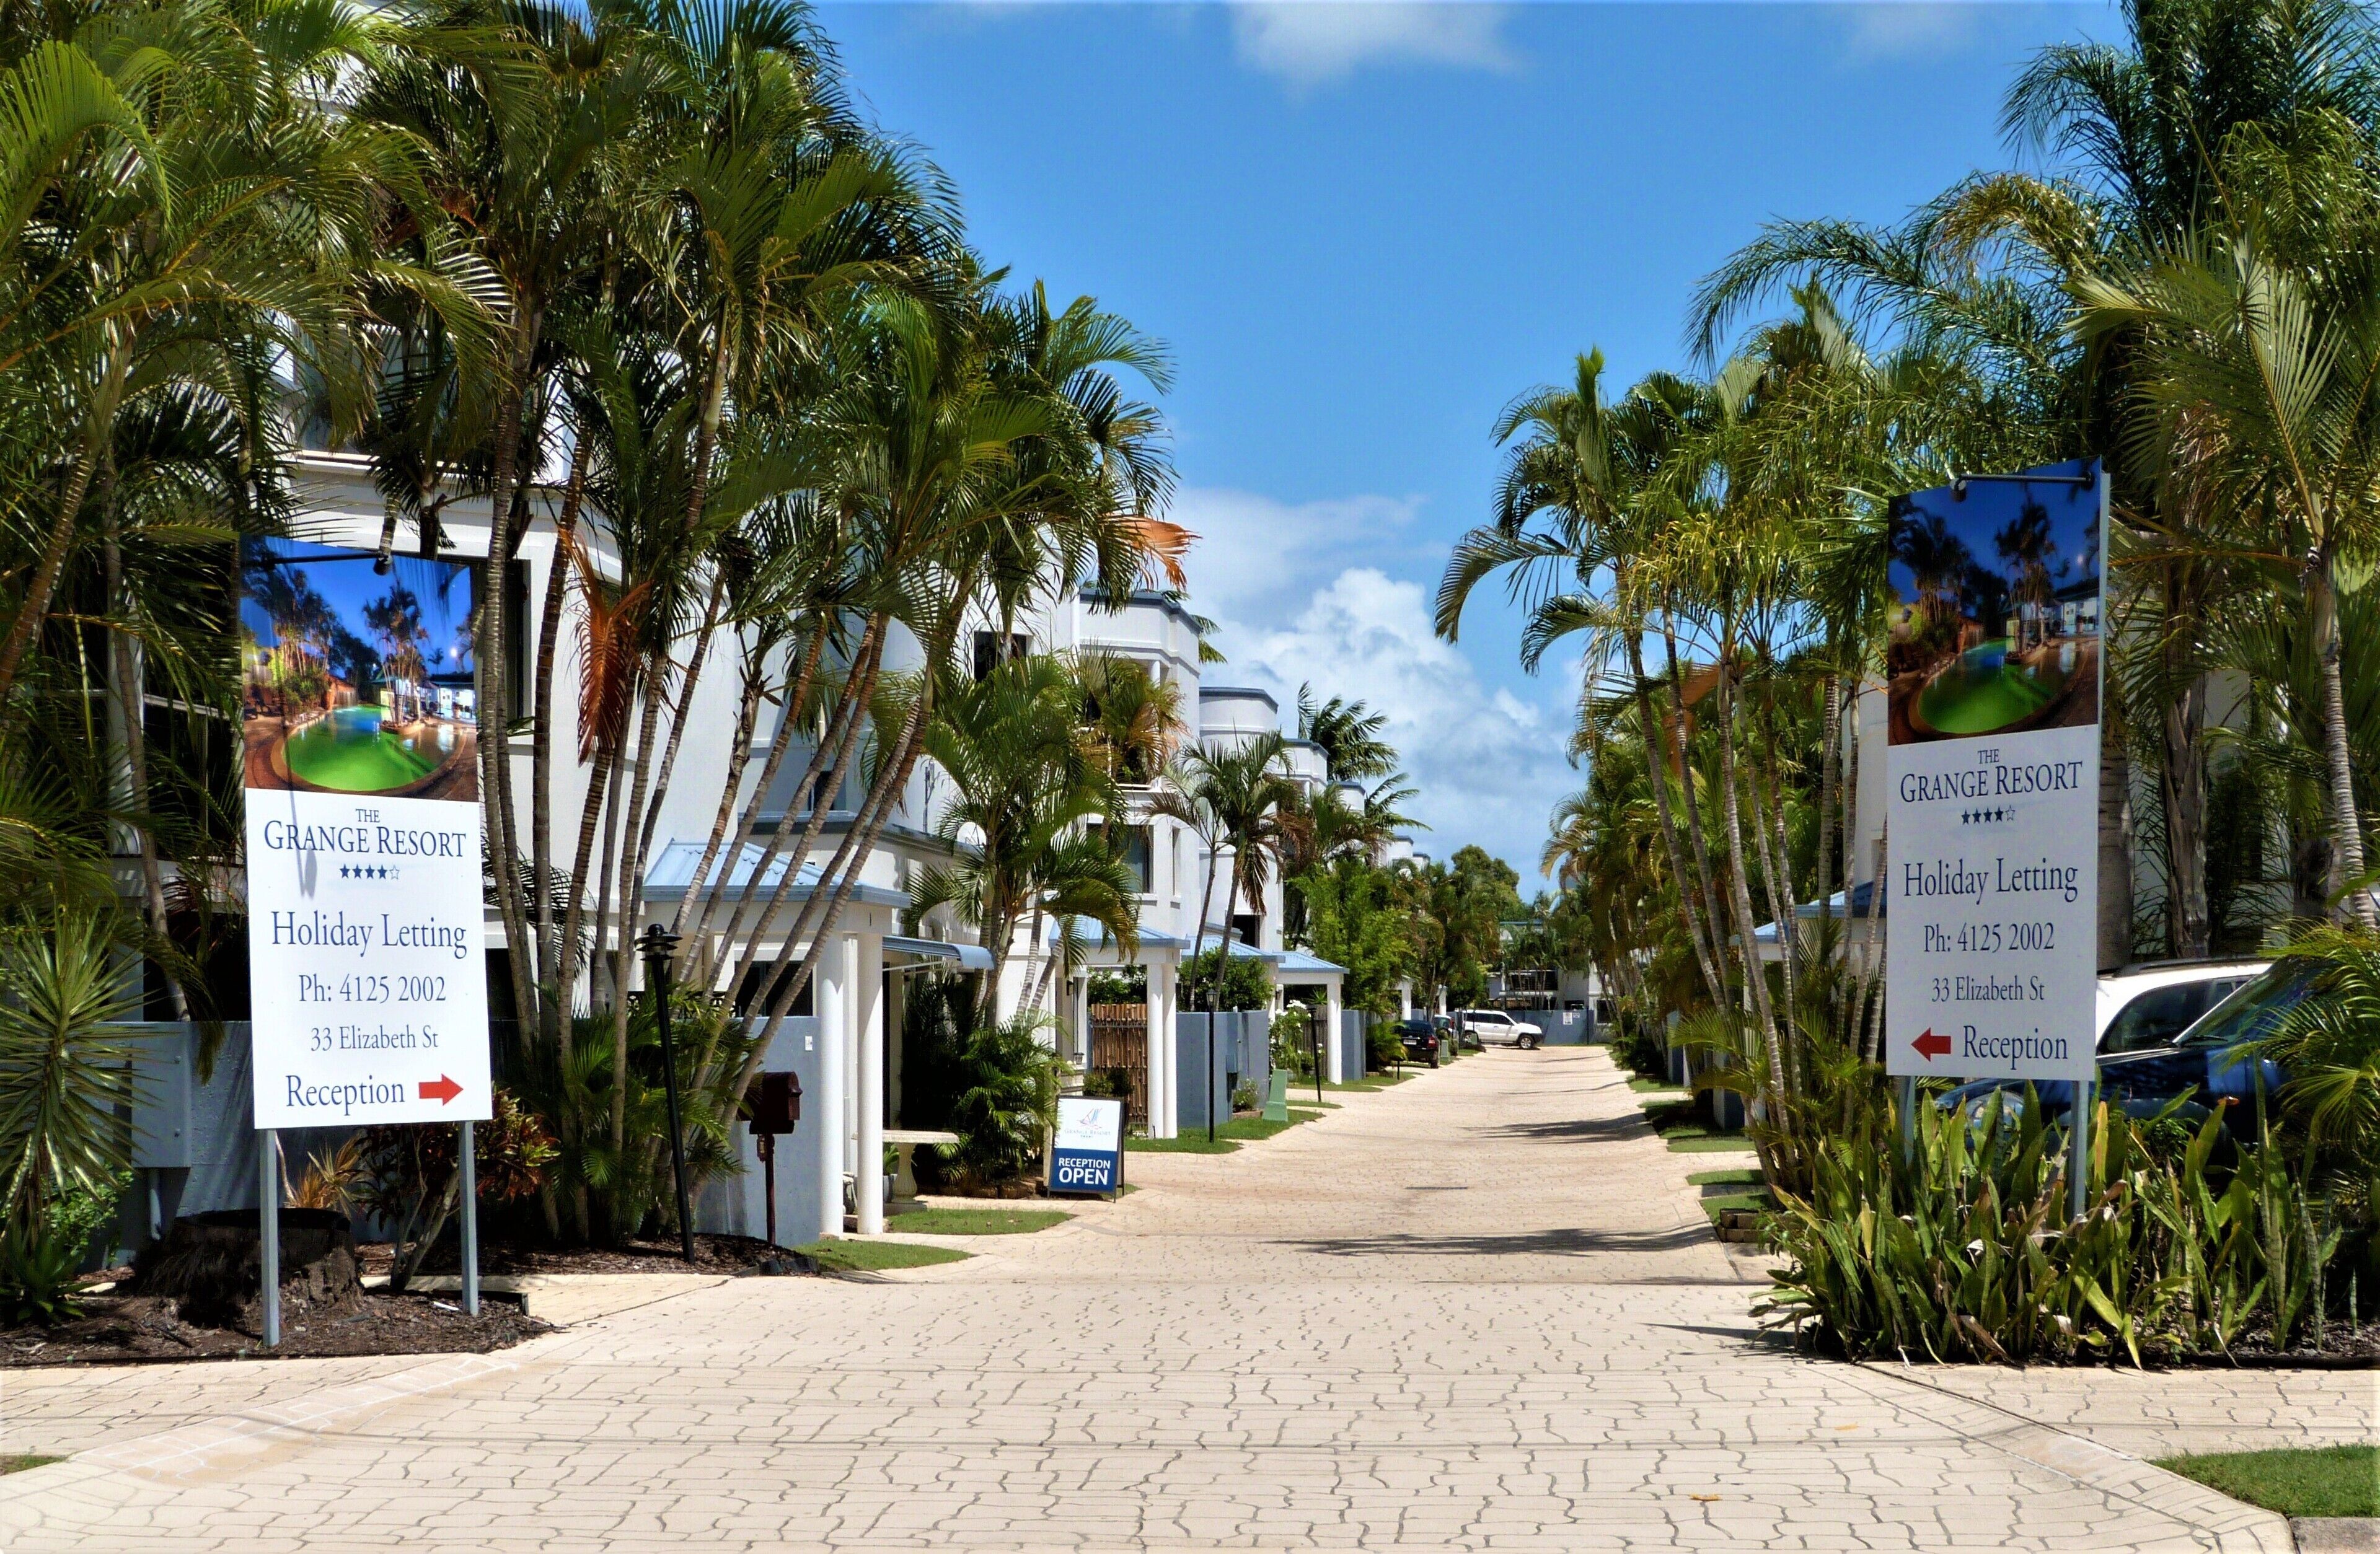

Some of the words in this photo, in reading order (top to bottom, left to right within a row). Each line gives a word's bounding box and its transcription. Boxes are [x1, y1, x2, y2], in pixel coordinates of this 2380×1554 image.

[1977, 748, 1999, 765] THE
[1900, 770, 1989, 803] GRANGE
[1994, 760, 2083, 796] RESORT
[355, 808, 381, 823] THE
[264, 820, 370, 854] GRANGE
[376, 826, 467, 858] RESORT
[1903, 858, 1990, 906] Holiday
[1996, 857, 2079, 903] Letting
[271, 910, 374, 958] Holiday
[381, 913, 467, 960] Letting
[1924, 923, 1951, 952] Ph:
[1957, 922, 2001, 954] 4125
[2008, 922, 2055, 950] 2002
[298, 973, 332, 1002] Ph:
[339, 973, 390, 1004] 4125
[398, 976, 446, 1002] 2002
[1931, 977, 1950, 1003] 33
[1955, 975, 2024, 1001] Elizabeth
[2029, 975, 2045, 1001] St
[311, 1027, 332, 1051] 33
[338, 1024, 417, 1049] Elizabeth
[422, 1025, 438, 1048] St
[1962, 1025, 2068, 1071] Reception
[285, 1074, 405, 1117] Reception
[1058, 1157, 1111, 1169] RECEPTION
[1059, 1167, 1108, 1185] OPEN
